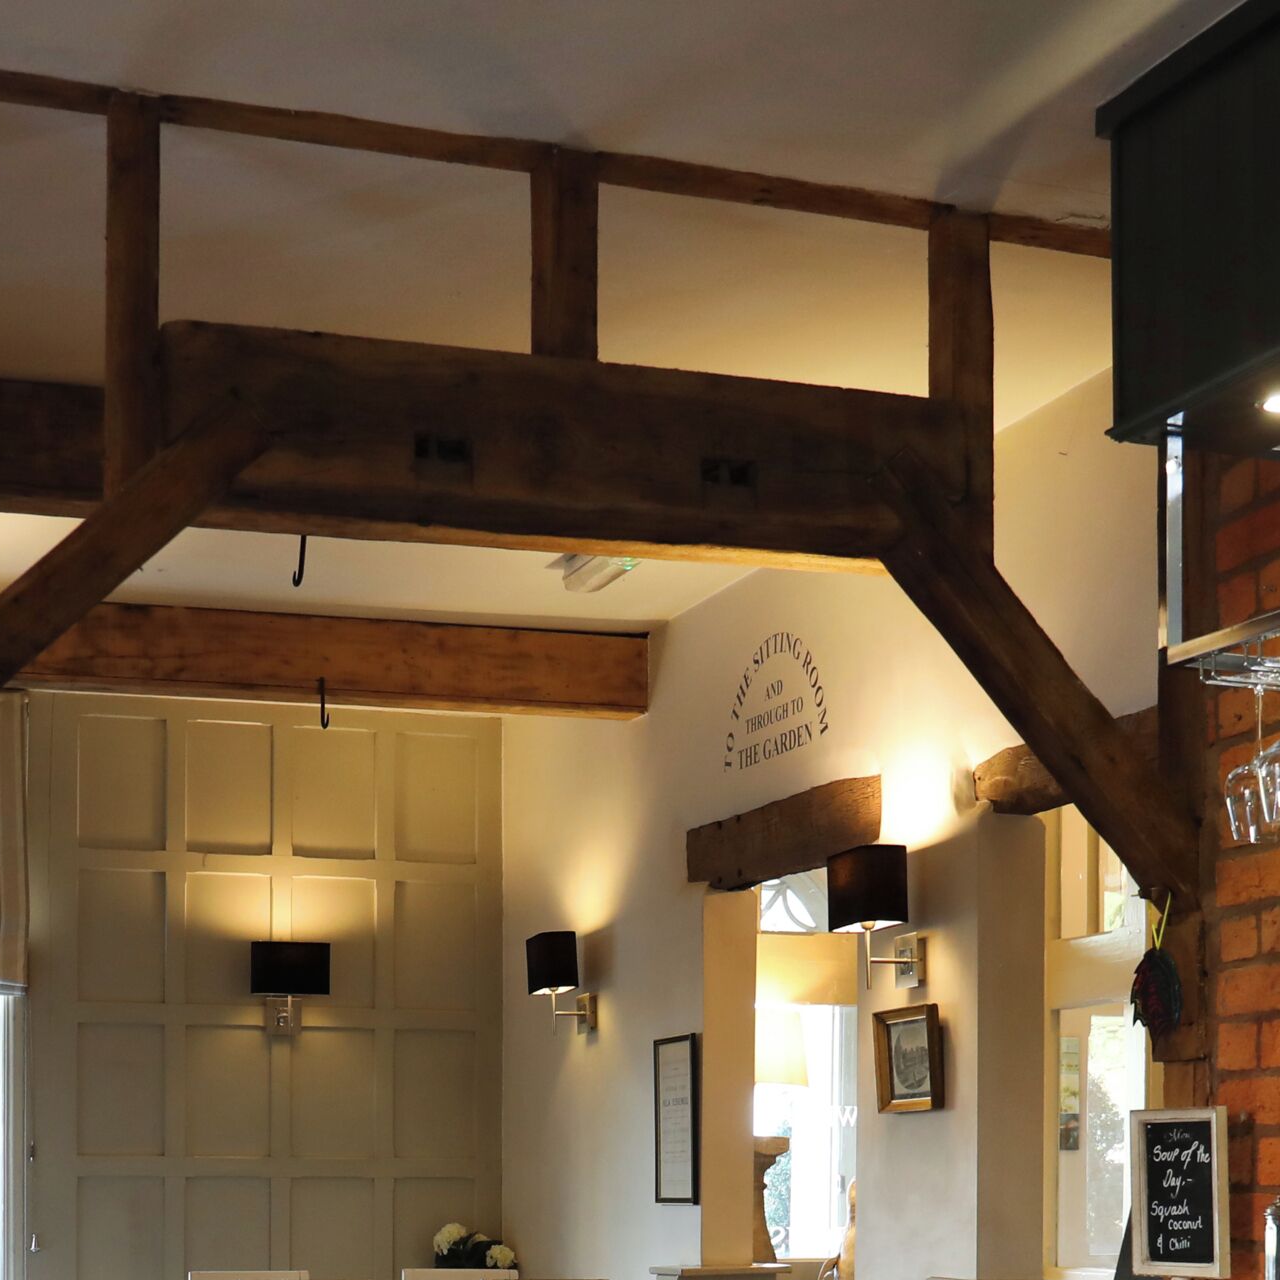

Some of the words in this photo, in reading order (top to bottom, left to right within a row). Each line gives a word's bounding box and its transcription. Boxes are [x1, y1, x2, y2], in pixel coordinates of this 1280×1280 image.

[723, 732, 735, 773] TO
[730, 667, 752, 721] THE
[752, 631, 802, 672] SITTING
[802, 650, 829, 735] ROOM
[765, 679, 783, 701] AND
[744, 702, 789, 735] THROUGH
[790, 696, 804, 715] TO
[737, 743, 760, 770] THE
[762, 721, 813, 761] GARDEN
[1153, 1144, 1180, 1162] Soup
[1180, 1141, 1199, 1170] of
[1150, 1198, 1190, 1223] Squash
